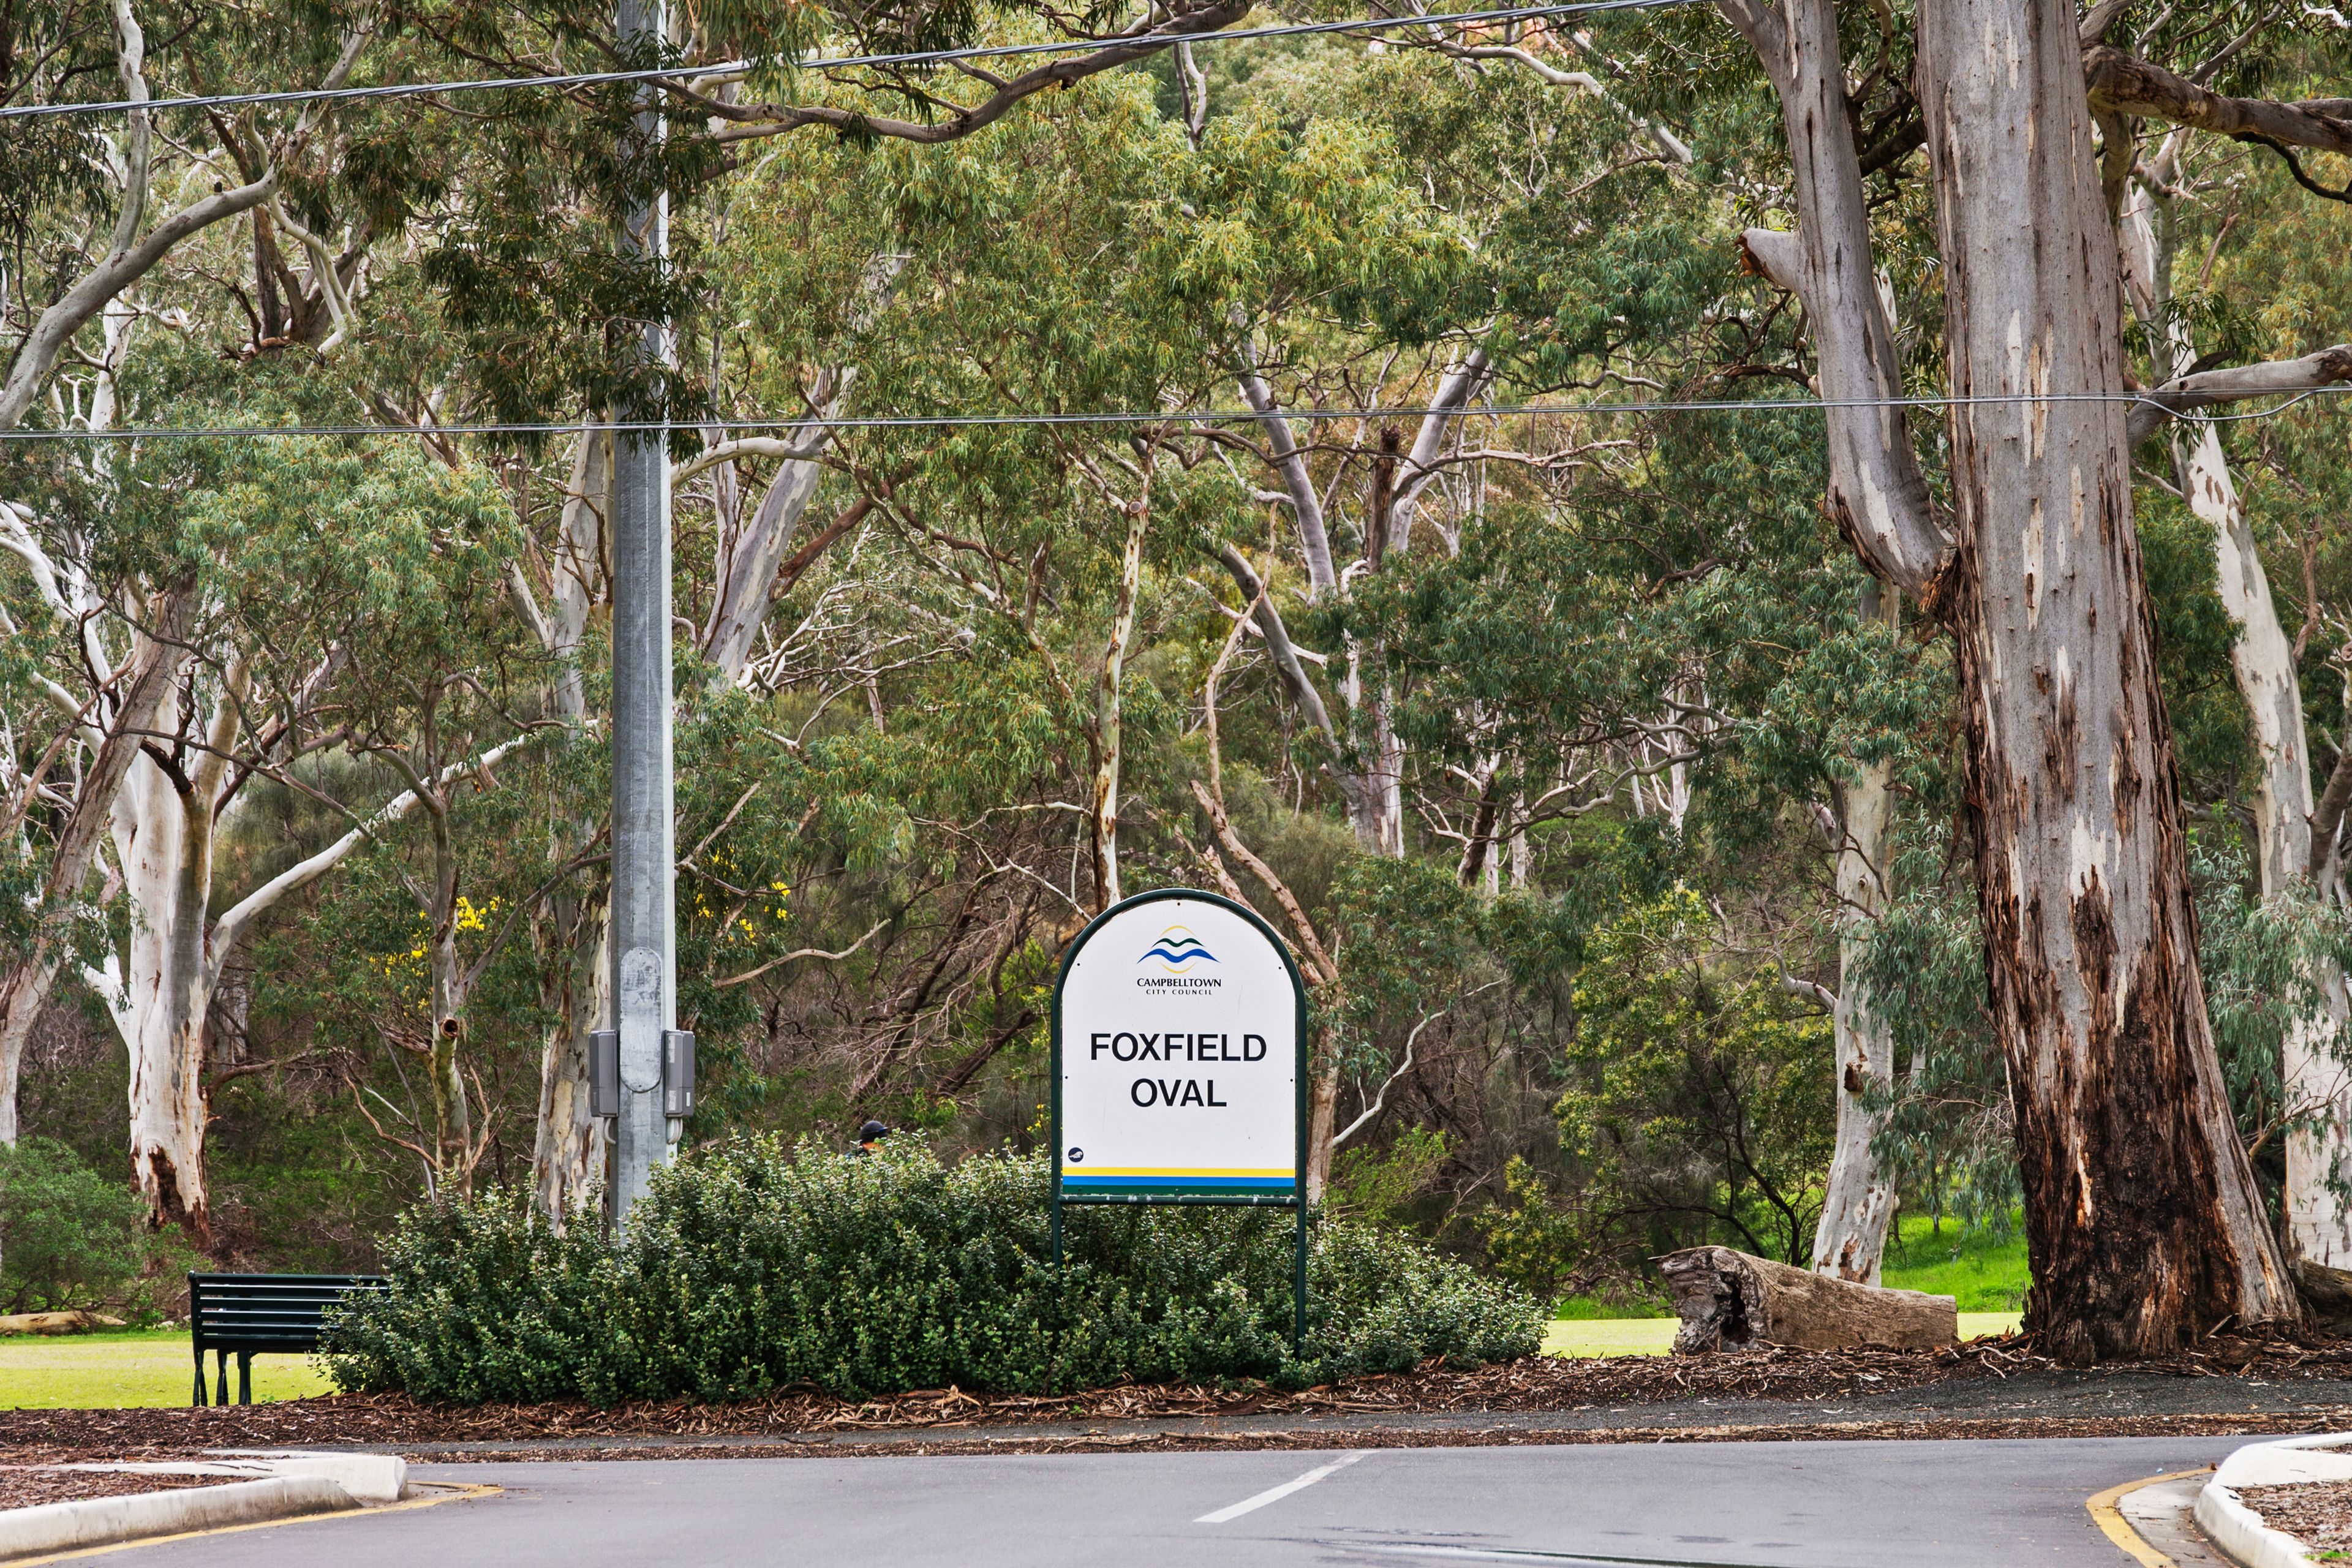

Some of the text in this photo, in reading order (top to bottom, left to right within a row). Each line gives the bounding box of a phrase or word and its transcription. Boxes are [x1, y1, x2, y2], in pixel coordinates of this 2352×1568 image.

[1137, 978, 1221, 987] CAMPBELLTOWN
[1090, 1032, 1267, 1062] FOXFIELD
[1131, 1078, 1227, 1108] OVAL
